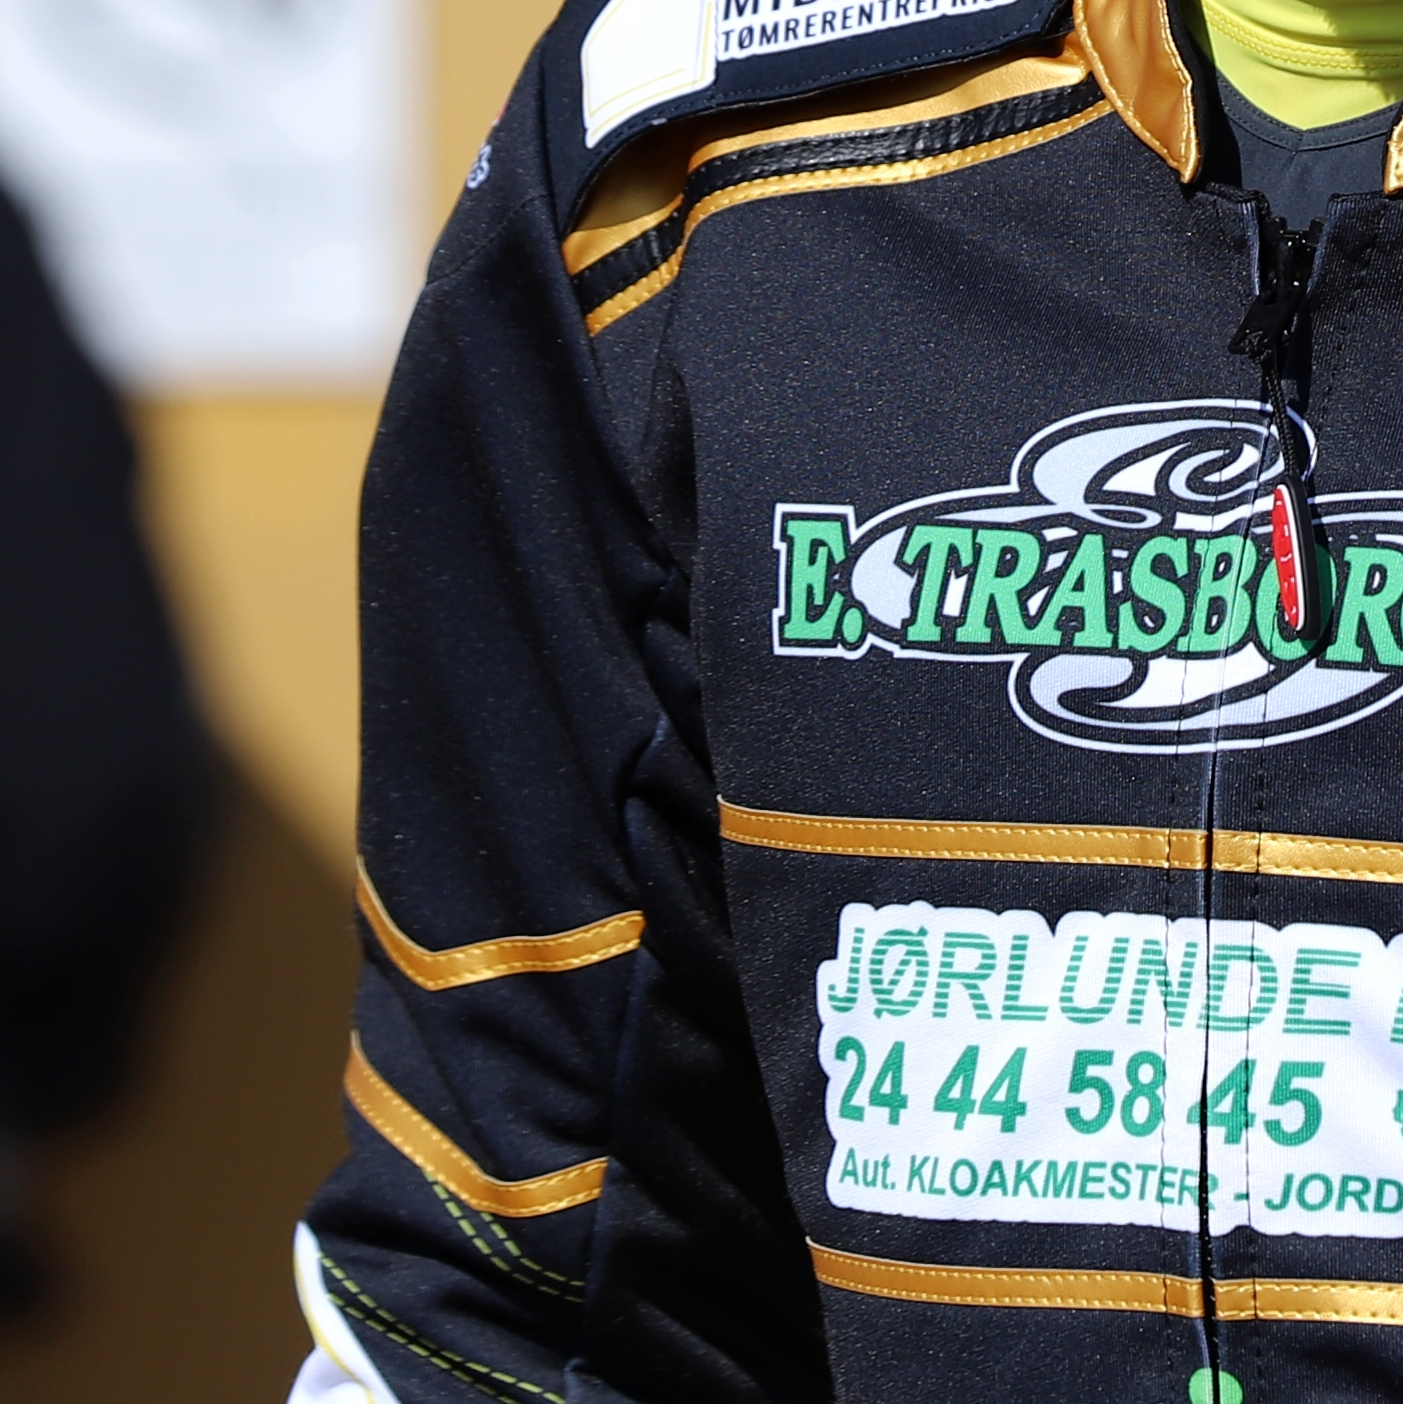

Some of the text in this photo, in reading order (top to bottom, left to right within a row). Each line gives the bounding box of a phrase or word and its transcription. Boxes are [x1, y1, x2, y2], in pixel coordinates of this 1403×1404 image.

[782, 518, 865, 645] E.
[827, 924, 1364, 1038] JØRLUNDE
[834, 1034, 1327, 1149] 24 44 58 45
[839, 1146, 897, 1192] Aut.
[905, 1154, 1221, 1212] KLOAKMESTER
